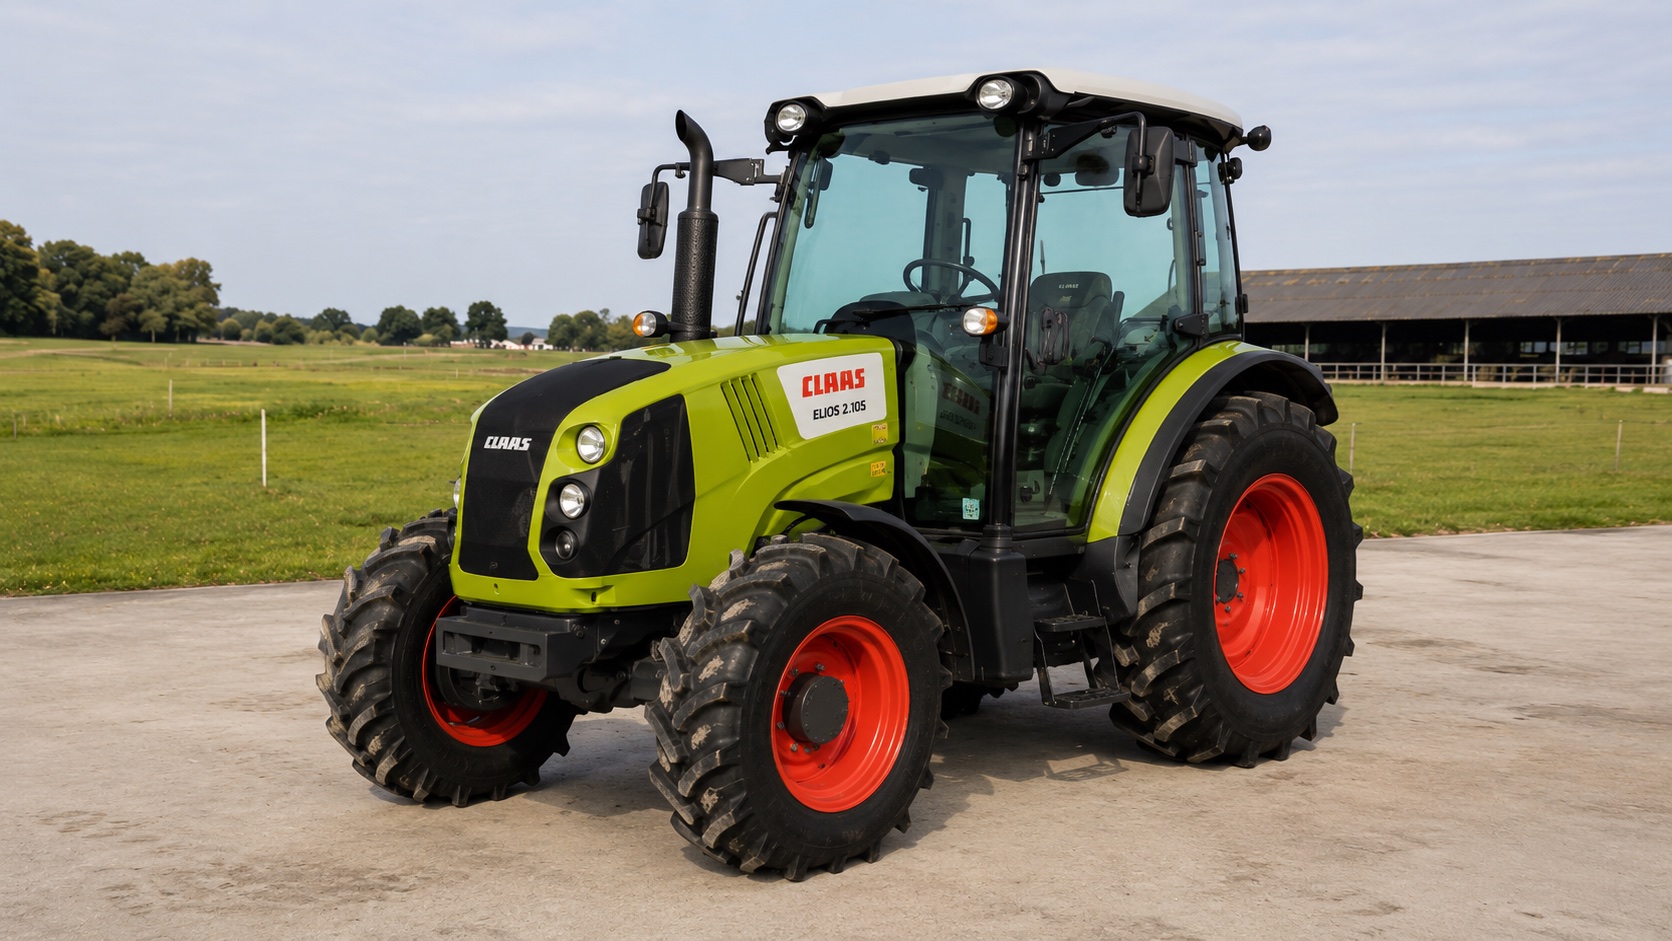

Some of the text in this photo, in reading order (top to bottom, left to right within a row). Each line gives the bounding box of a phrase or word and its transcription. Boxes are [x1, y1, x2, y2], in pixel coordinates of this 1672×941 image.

[802, 368, 865, 398] CLAAS
[813, 400, 867, 420] ELIOS 2.105
[483, 435, 533, 451] CLAAS
